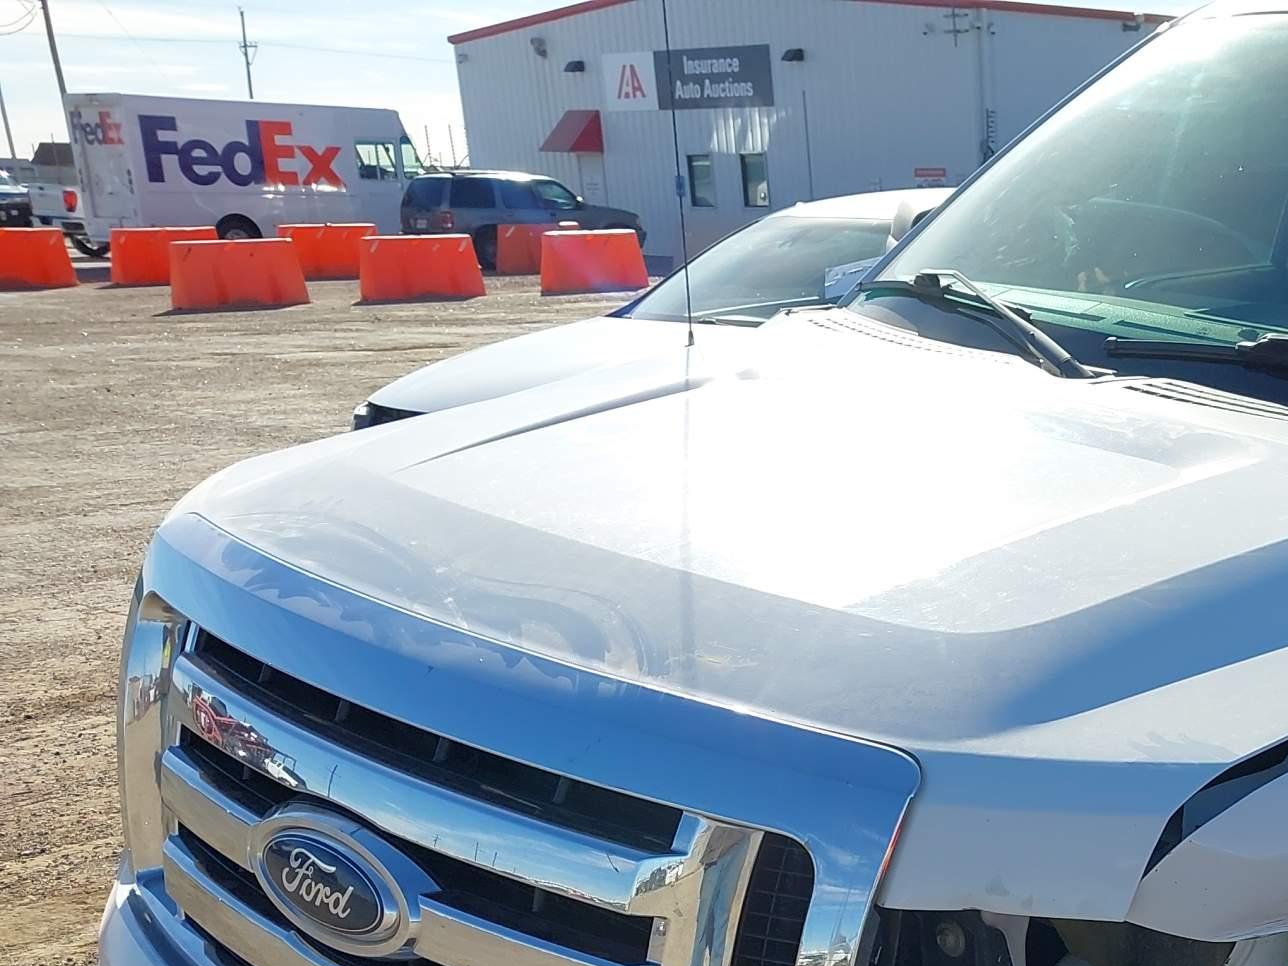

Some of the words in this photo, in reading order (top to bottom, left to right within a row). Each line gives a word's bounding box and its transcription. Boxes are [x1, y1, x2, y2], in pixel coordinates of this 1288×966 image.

[682, 55, 740, 75] Insurance
[674, 79, 701, 100] Auto
[703, 77, 754, 98] Auctions
[68, 109, 124, 146] FedEx
[137, 114, 348, 188] FedEx
[281, 847, 355, 919] Ford
